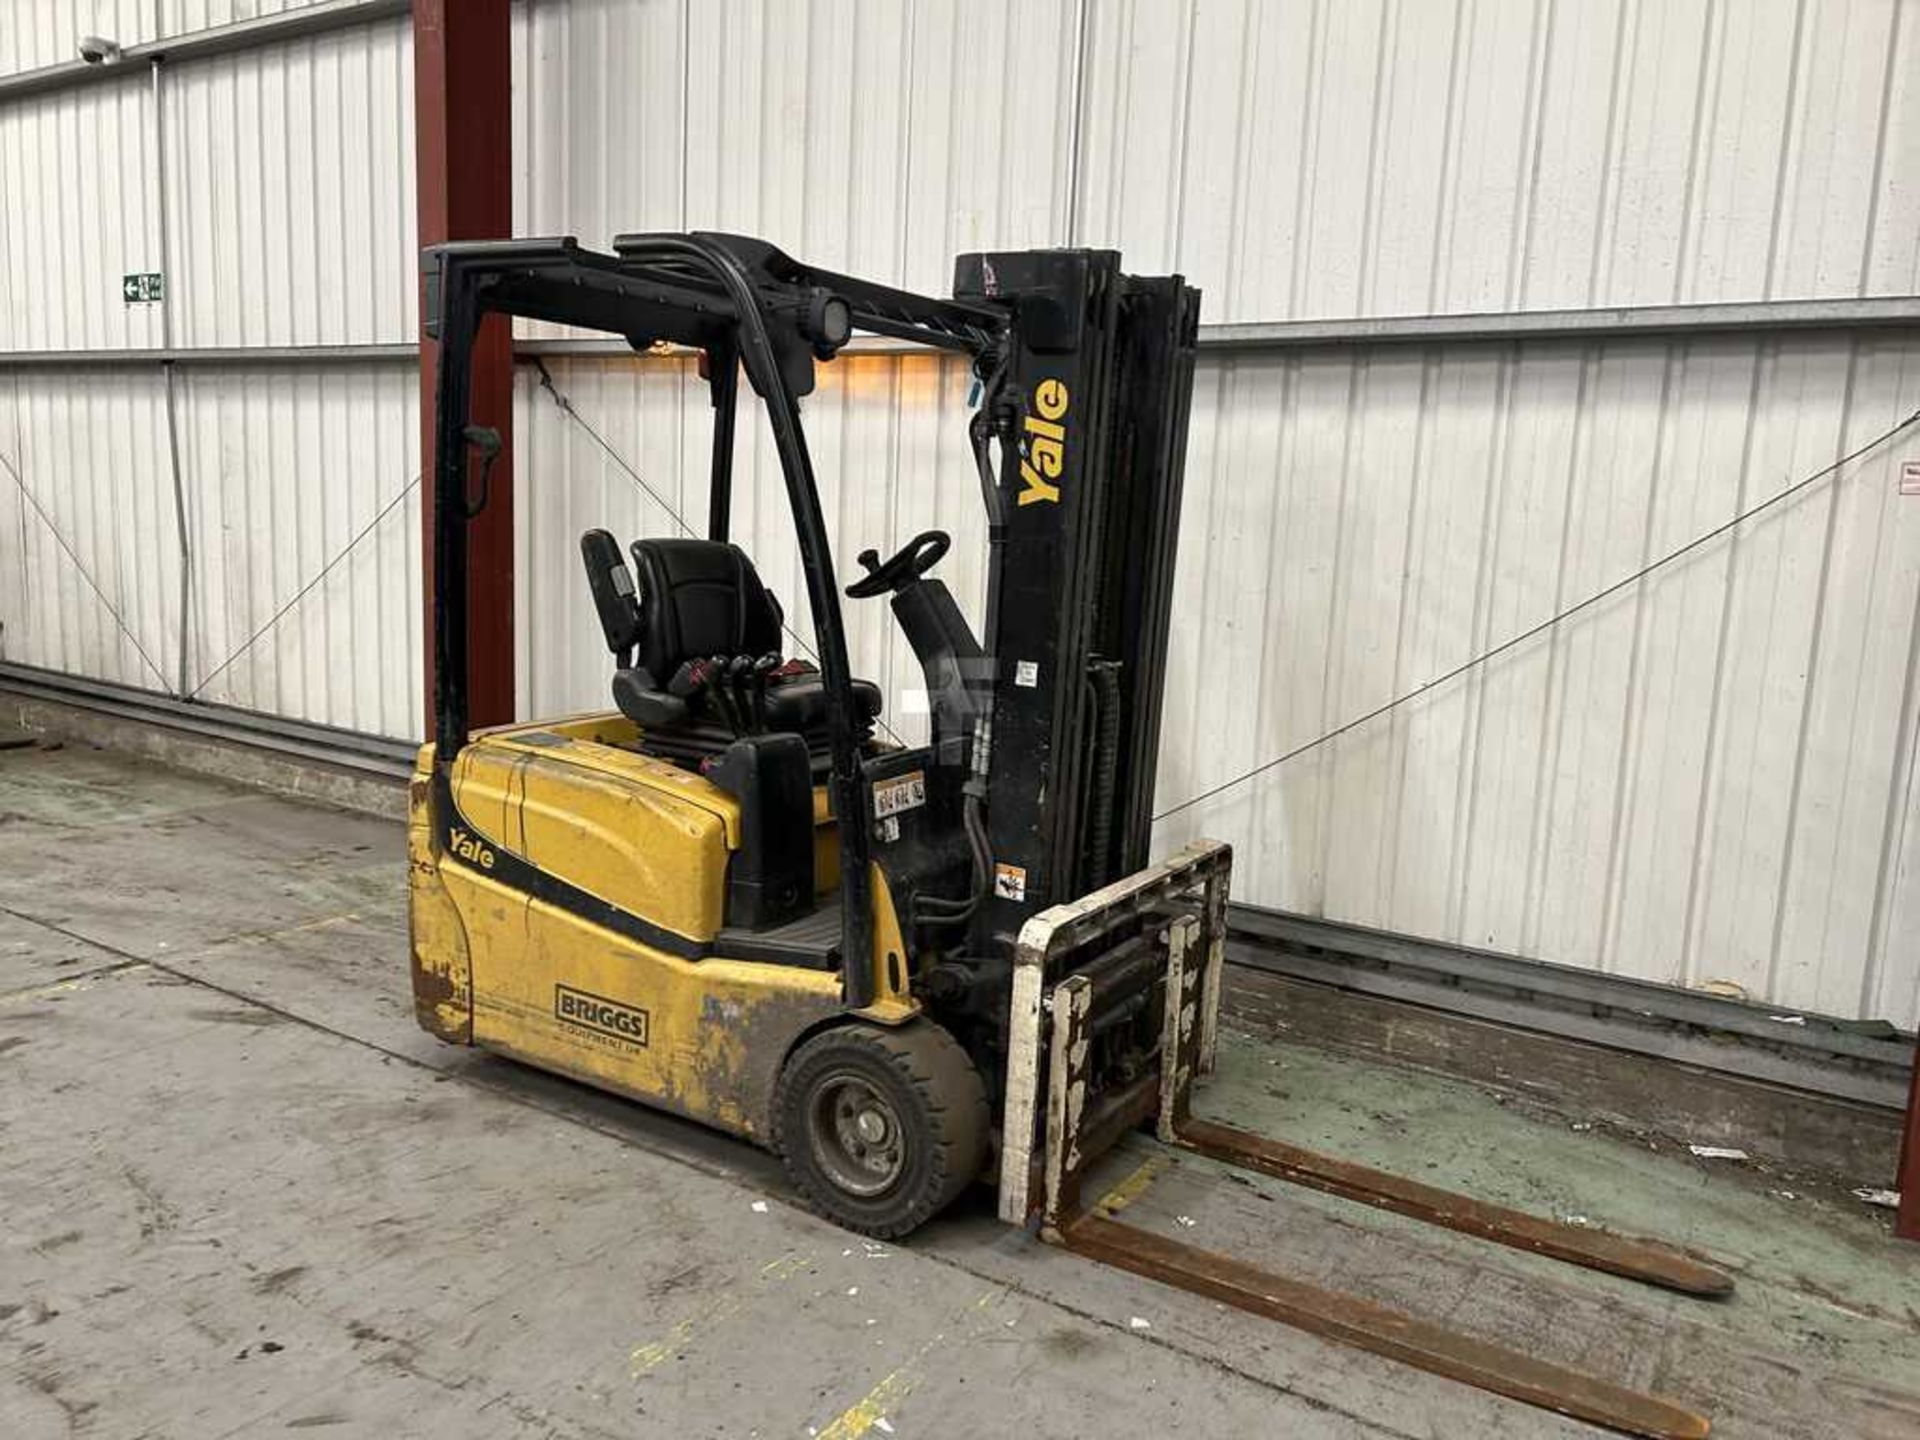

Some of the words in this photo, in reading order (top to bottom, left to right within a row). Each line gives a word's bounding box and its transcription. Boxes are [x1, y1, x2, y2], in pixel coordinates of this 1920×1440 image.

[1018, 379, 1068, 506] Yale
[450, 827, 494, 869] Yale
[561, 993, 642, 1038] BRIGGS
